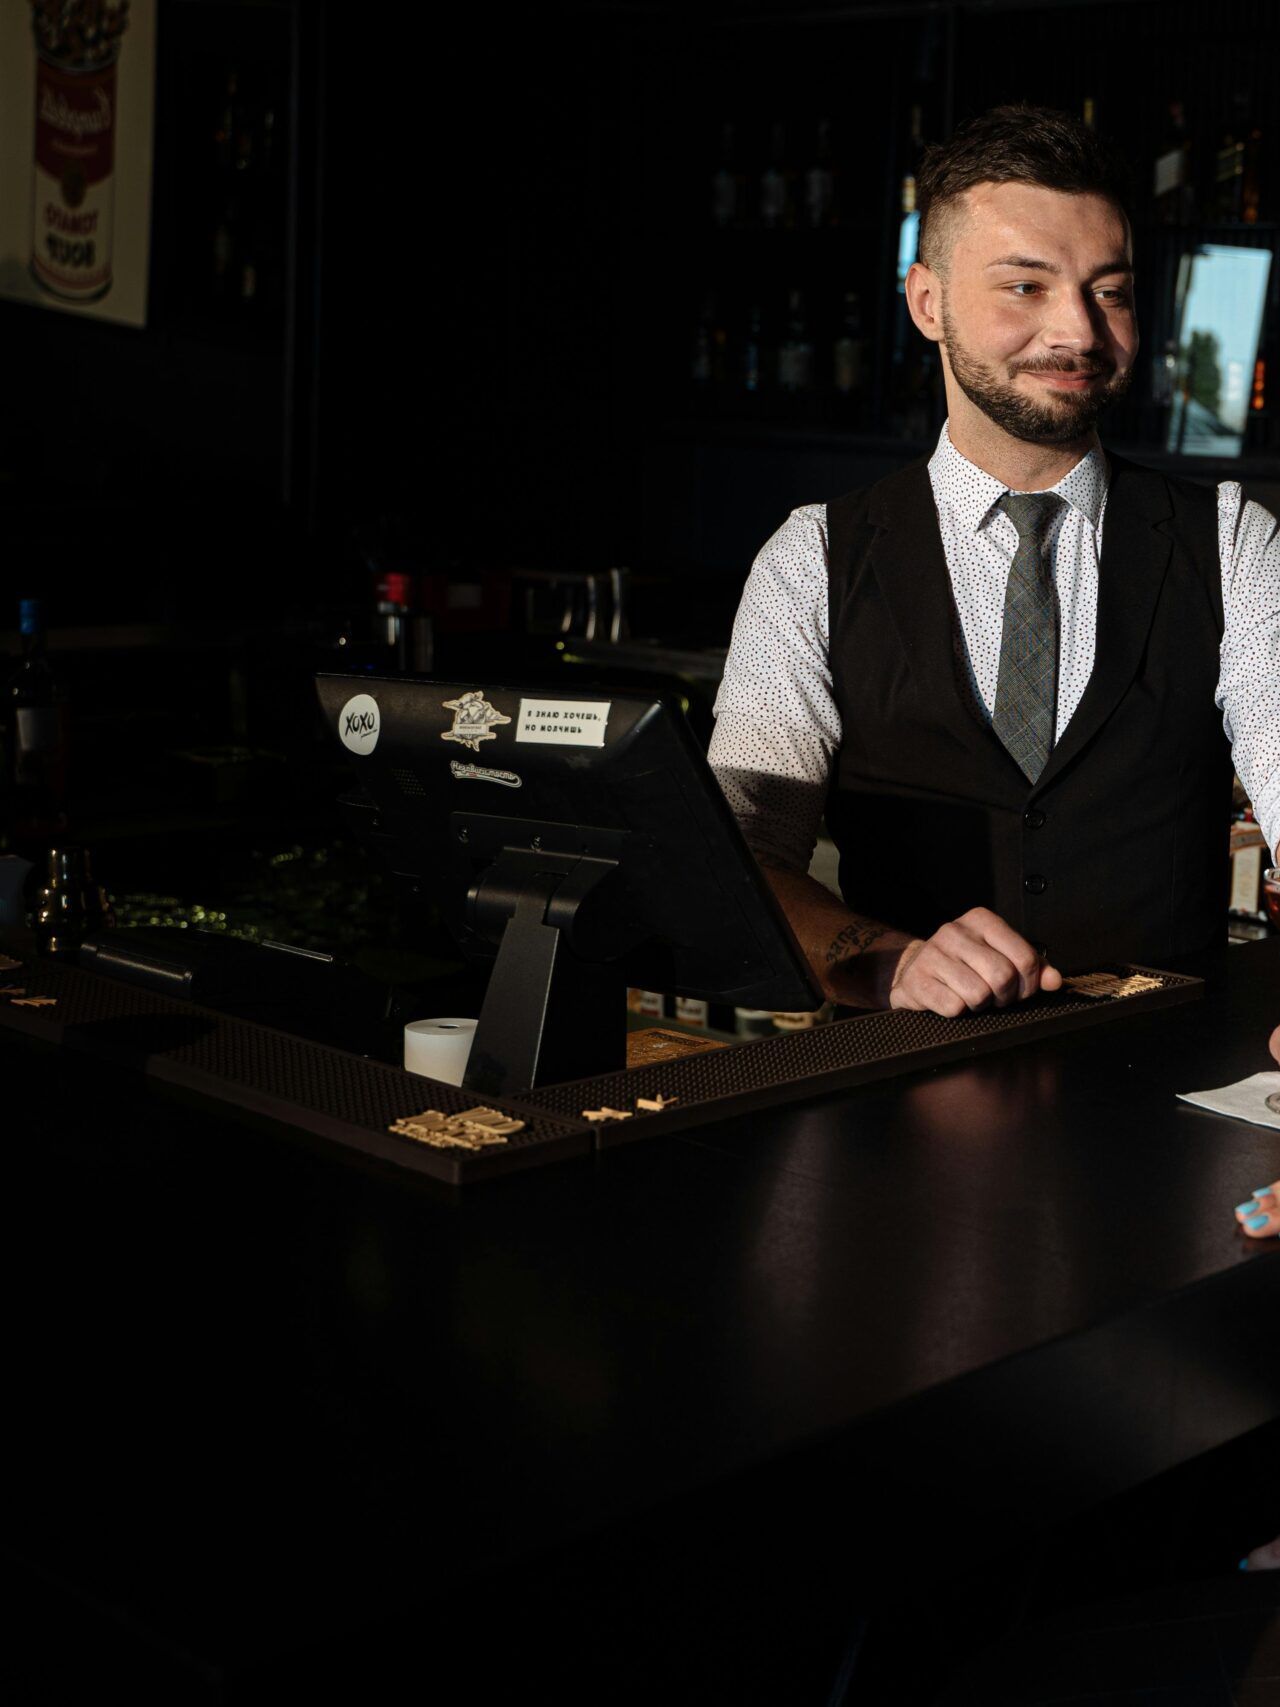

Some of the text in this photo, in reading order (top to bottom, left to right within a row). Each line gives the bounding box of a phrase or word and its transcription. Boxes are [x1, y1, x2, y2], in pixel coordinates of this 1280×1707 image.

[536, 710, 560, 719] ЗНАЮ
[345, 712, 375, 736] XOXO
[525, 724, 582, 734] НО МОЛЧИШЬ
